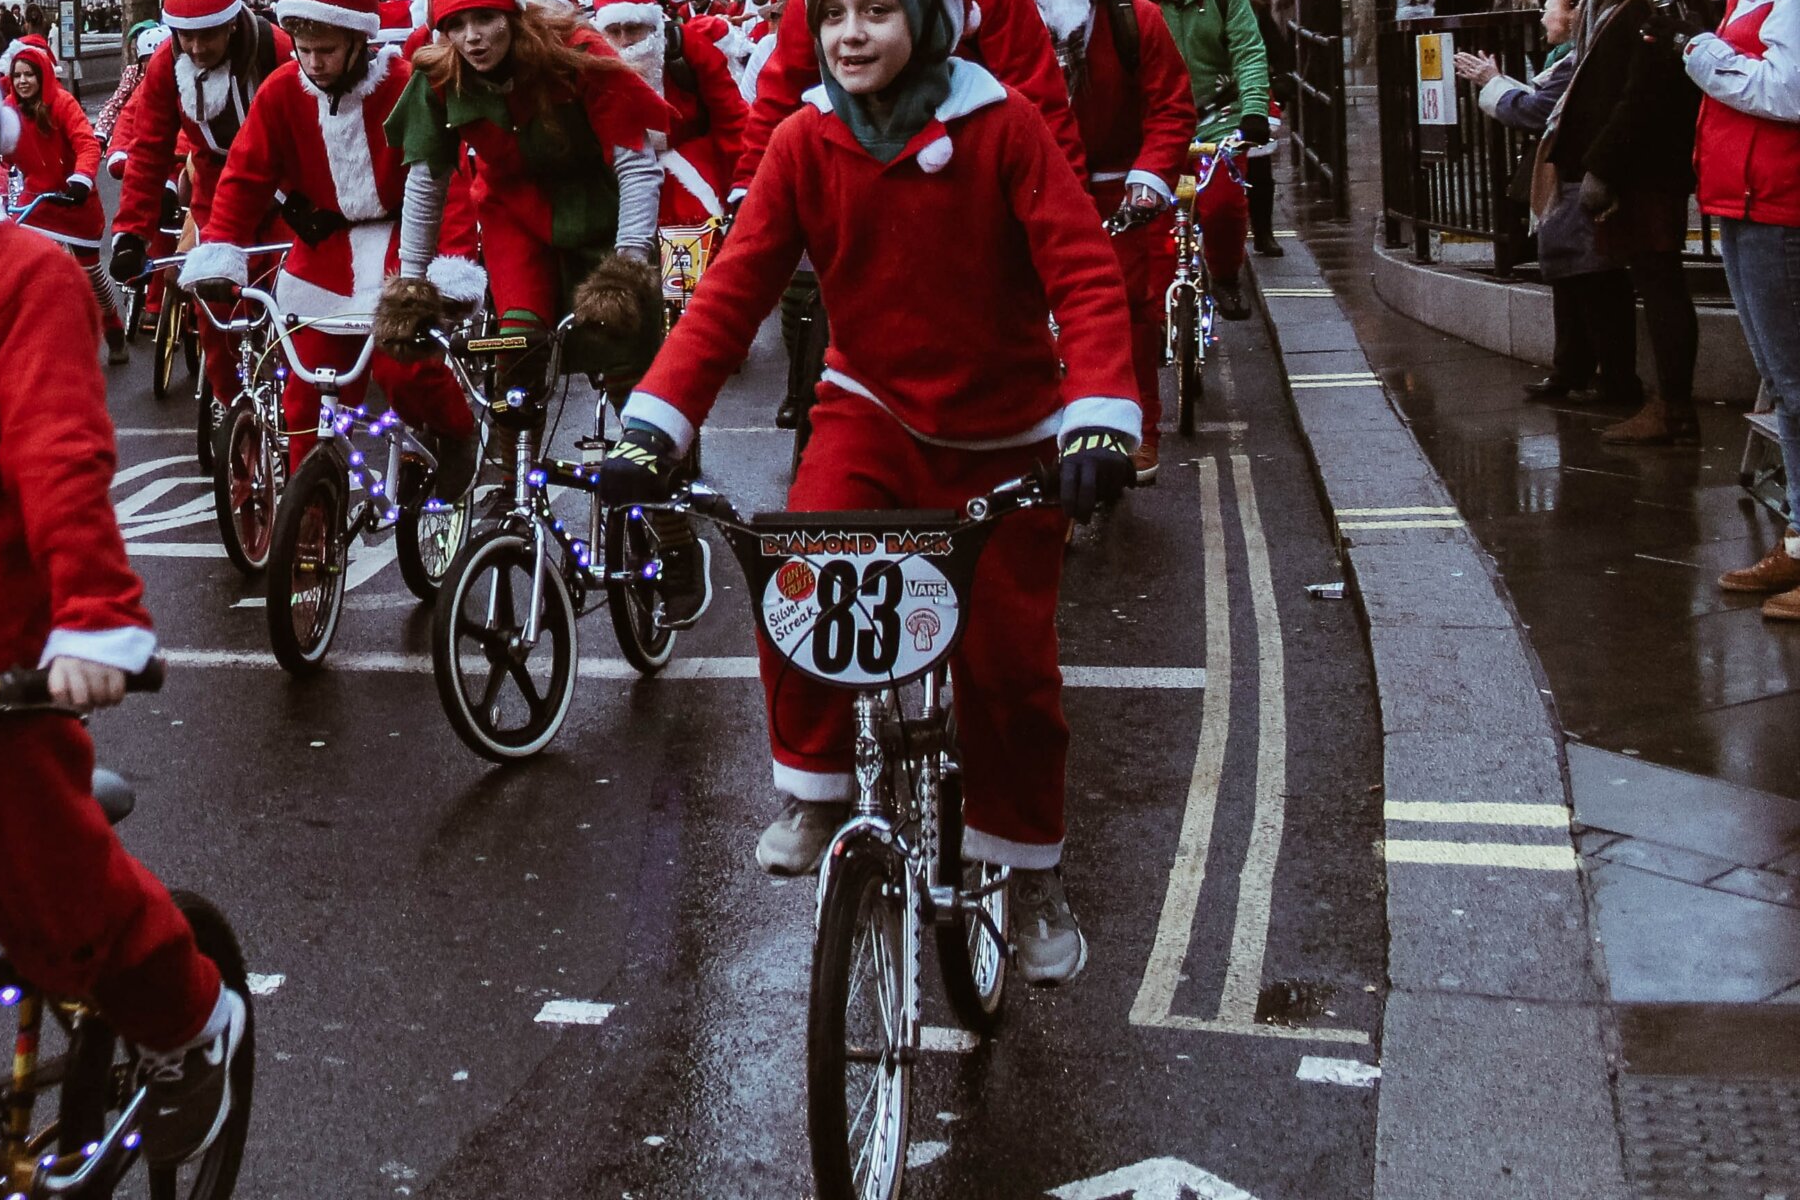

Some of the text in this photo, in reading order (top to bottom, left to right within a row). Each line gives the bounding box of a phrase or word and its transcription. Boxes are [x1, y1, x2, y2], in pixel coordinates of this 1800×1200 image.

[760, 530, 954, 557] DIAMOND BACK
[782, 562, 810, 589] SANTA
[906, 580, 948, 597] VANS
[769, 601, 800, 627] Silver
[775, 606, 818, 642] Streak
[812, 559, 904, 675] 83
